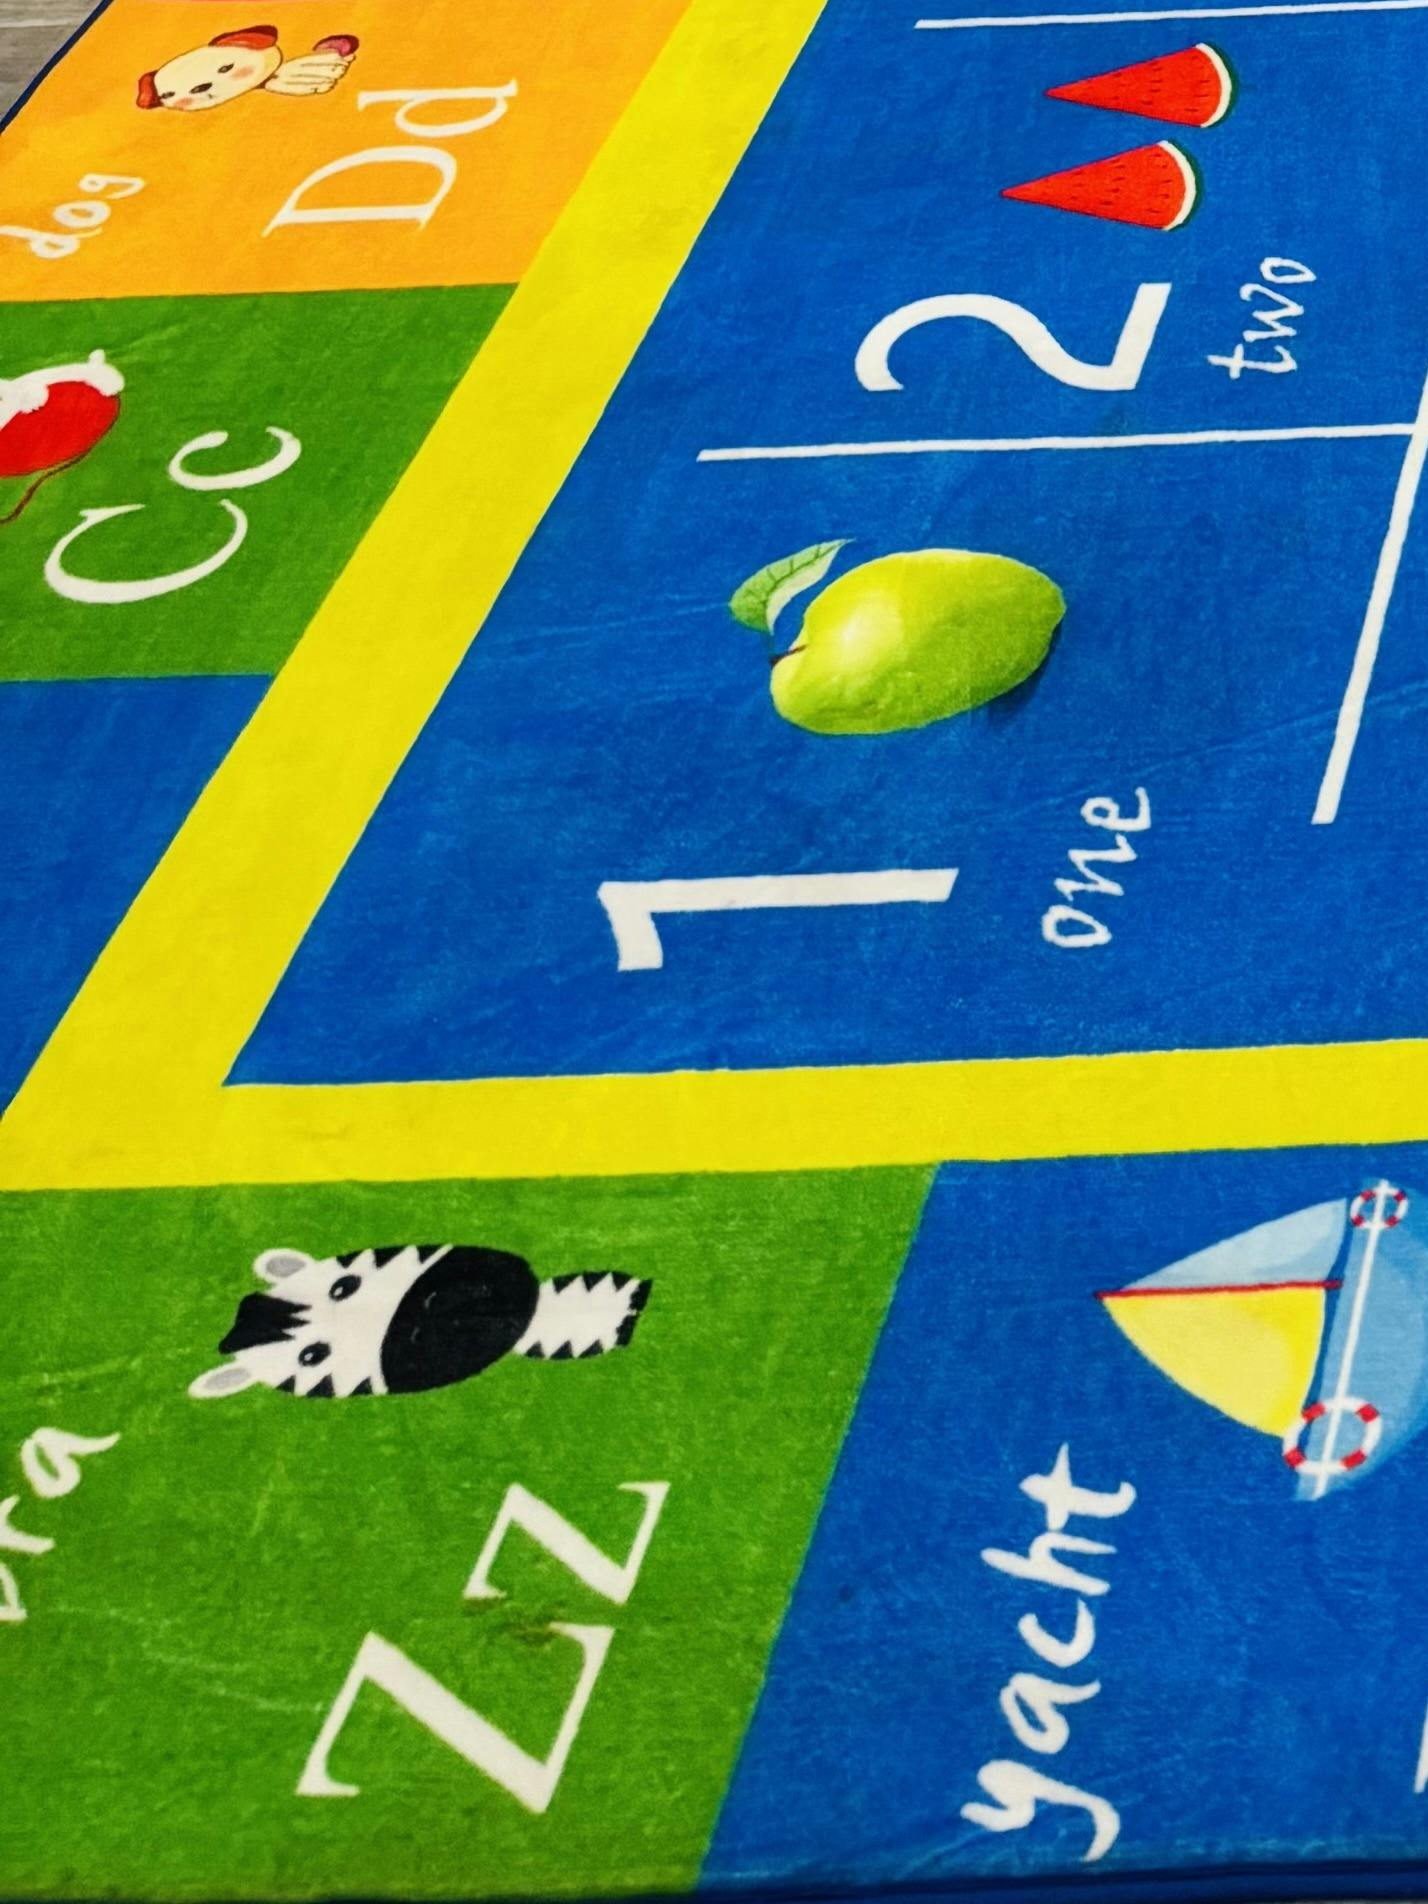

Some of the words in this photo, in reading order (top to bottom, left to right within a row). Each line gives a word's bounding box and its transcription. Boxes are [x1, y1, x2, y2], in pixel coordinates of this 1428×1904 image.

[0, 172, 147, 261] dog
[260, 76, 519, 239] Dd
[854, 282, 1172, 392] 2
[1207, 256, 1317, 380] two
[43, 426, 302, 605] Cc
[597, 868, 959, 972] 1
[1041, 786, 1152, 948] one
[296, 1481, 671, 1814] Zz
[960, 1444, 1137, 1862] yacht
